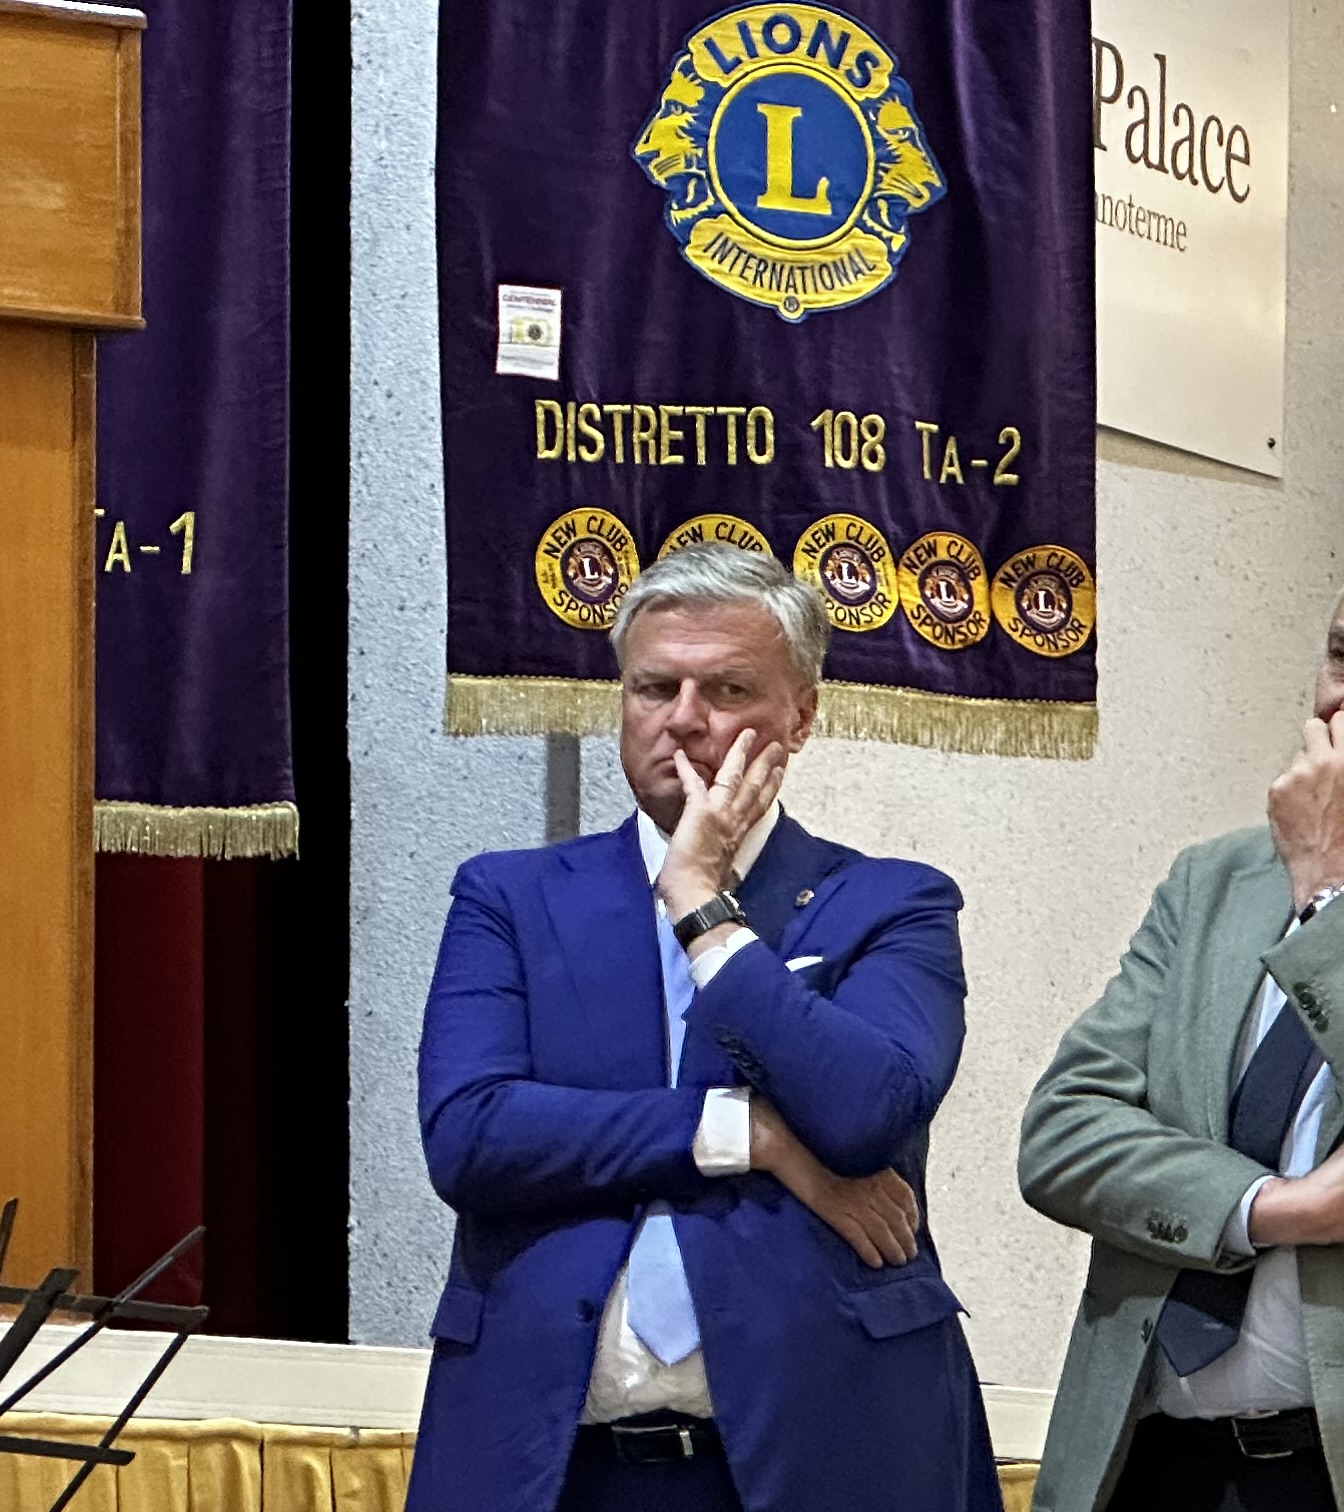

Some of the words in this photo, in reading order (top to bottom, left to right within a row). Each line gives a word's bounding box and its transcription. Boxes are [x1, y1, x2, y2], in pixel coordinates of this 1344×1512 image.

[703, 13, 881, 89] LIONS
[1092, 36, 1251, 203] Palace
[756, 103, 833, 216] L
[702, 231, 877, 294] INTERNATIONAL
[535, 400, 775, 466] DISTRETTO
[809, 408, 887, 473] 108
[94, 507, 195, 575] A-1
[543, 519, 577, 560] NEW
[586, 515, 629, 552] CLUB
[801, 522, 836, 560] NEW
[845, 522, 886, 565] CLUB
[581, 557, 600, 580] L
[840, 562, 857, 583] L
[903, 538, 938, 577] NEW
[946, 540, 981, 581] CLUB
[999, 552, 1037, 589] NEW
[1045, 552, 1086, 589] CLUB
[818, 592, 892, 626] PONSOR
[938, 580, 955, 602] L
[1037, 590, 1053, 613] L
[910, 603, 989, 646] SPONSOR
[1007, 616, 1086, 651] SPONSOR
